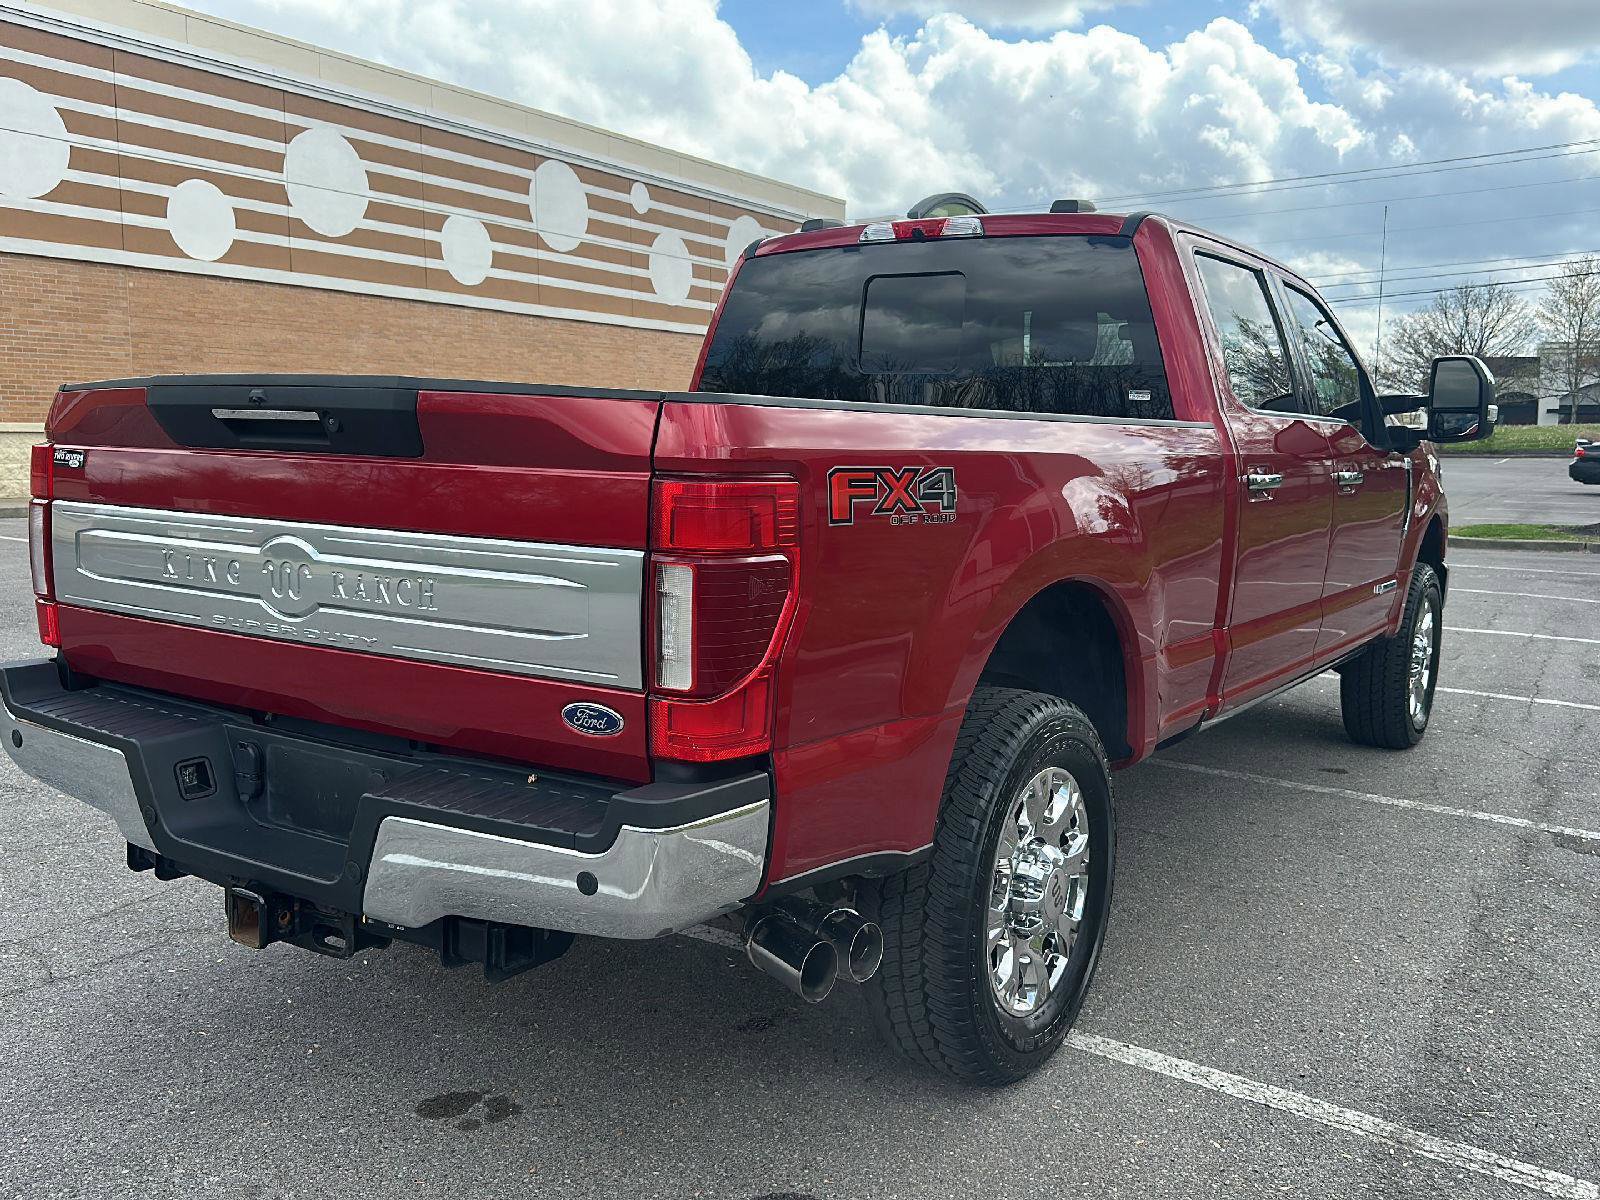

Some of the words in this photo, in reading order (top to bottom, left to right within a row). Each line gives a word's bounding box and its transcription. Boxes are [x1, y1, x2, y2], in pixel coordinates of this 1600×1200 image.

[827, 465, 958, 527] FX4
[889, 514, 919, 527] OFF
[922, 512, 957, 525] ROAD
[161, 548, 241, 586] KING
[331, 570, 440, 612] RANCH
[211, 613, 298, 637] SUPER
[302, 626, 379, 649] DUTY
[573, 708, 608, 729] Ford
